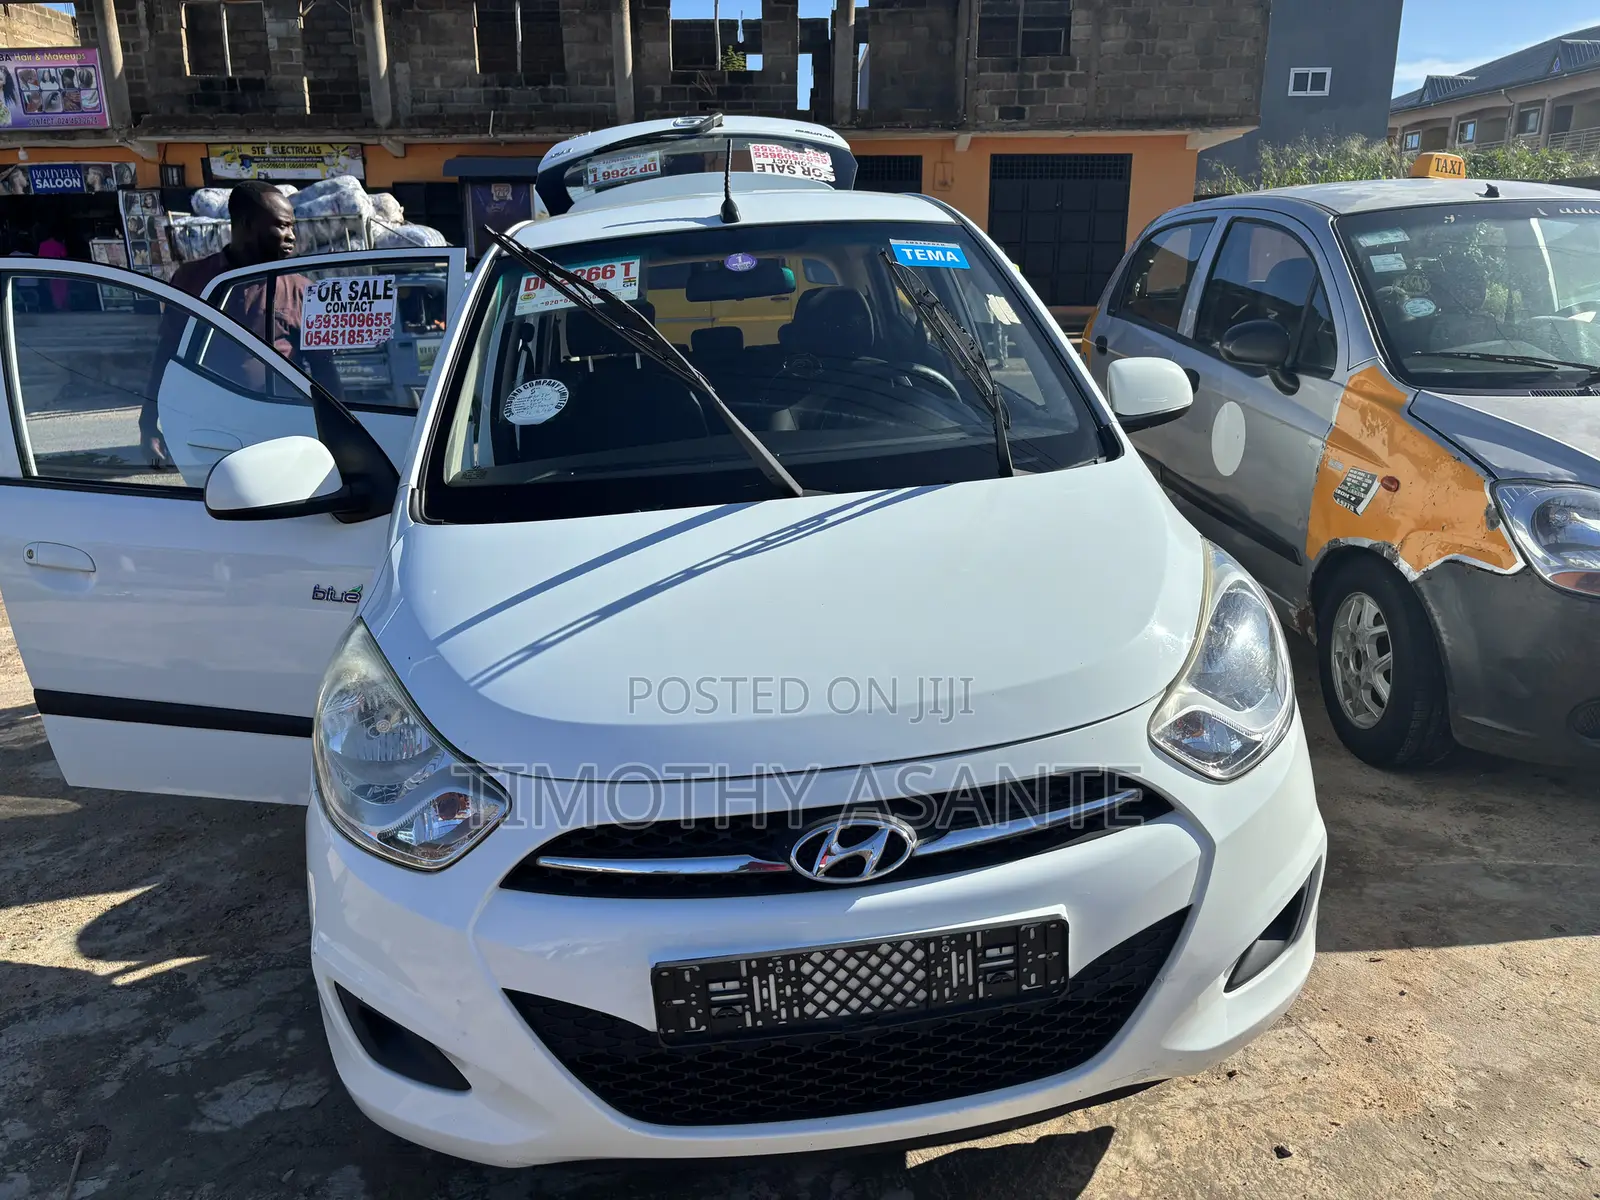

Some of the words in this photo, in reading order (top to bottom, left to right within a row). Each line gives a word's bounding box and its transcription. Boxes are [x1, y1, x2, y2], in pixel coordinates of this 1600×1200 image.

[14, 52, 32, 61] Hair
[35, 52, 41, 61] &
[44, 52, 86, 62] Makeups
[272, 146, 322, 155] ELECTRICALS
[602, 166, 637, 180] 2266
[639, 162, 657, 173] DP
[756, 162, 796, 175] SALE
[1435, 157, 1462, 176] TAXI
[35, 178, 81, 188] SALOON
[591, 173, 600, 183] T
[901, 248, 960, 262] TEMA
[621, 261, 635, 277] T
[347, 279, 393, 301] SALE
[325, 301, 374, 313] CONTACT
[522, 379, 562, 391] COMPANY
[555, 386, 568, 410] LIMITED
[312, 583, 362, 603] blue
